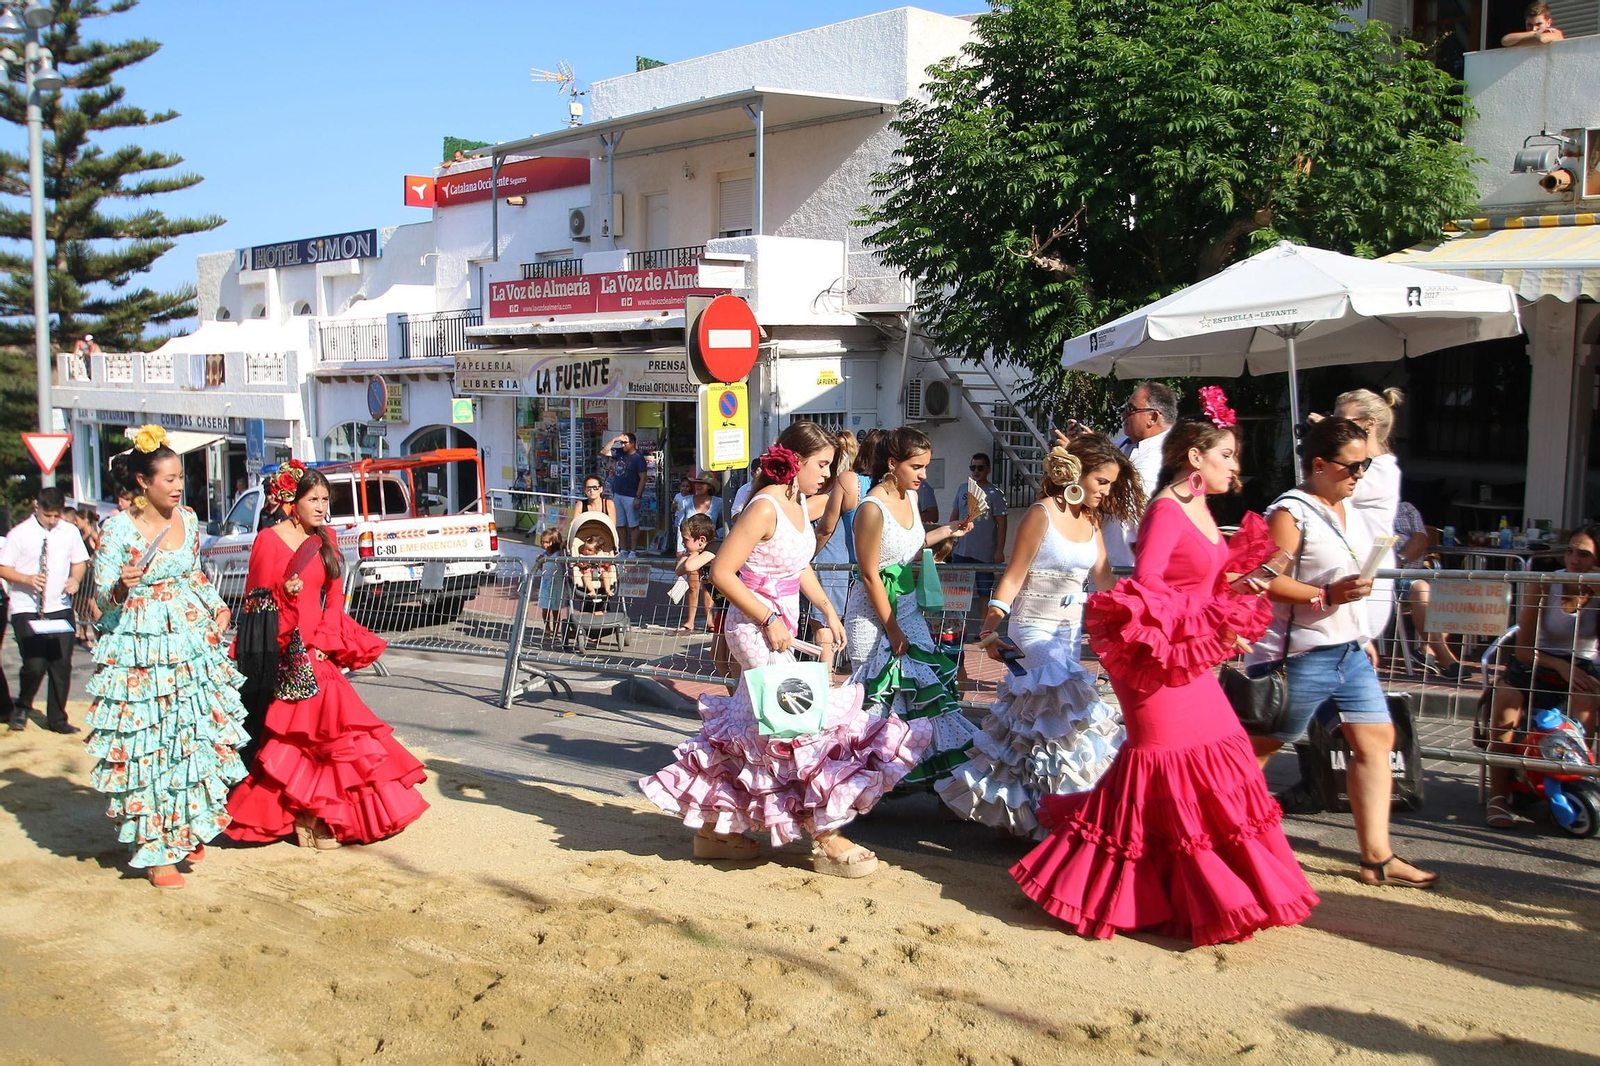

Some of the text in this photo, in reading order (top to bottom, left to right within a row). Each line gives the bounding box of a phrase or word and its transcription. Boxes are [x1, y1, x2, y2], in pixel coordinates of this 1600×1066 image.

[450, 182, 477, 195] Catalana
[477, 176, 509, 191] Occiente
[254, 243, 302, 270] HOTEL
[492, 277, 590, 302] La Voz de Almería
[600, 270, 700, 294] La Voz de Alme
[637, 296, 687, 306] www.lavozdealmeri
[1213, 313, 1253, 325] ESTRELLA
[1260, 308, 1298, 318] LEVANTE
[456, 361, 512, 370] PAPELERIA
[648, 360, 686, 371] PRENSA
[463, 379, 519, 389] LIBRERIA
[536, 357, 610, 395] LA FUENTE
[628, 382, 700, 394] Material OFICINA/ESCO
[161, 414, 230, 430] COMDAS CASERA
[377, 539, 468, 556] C-80 EMERGENCIAS
[1486, 585, 1504, 597] DE
[1330, 750, 1347, 770] LA
